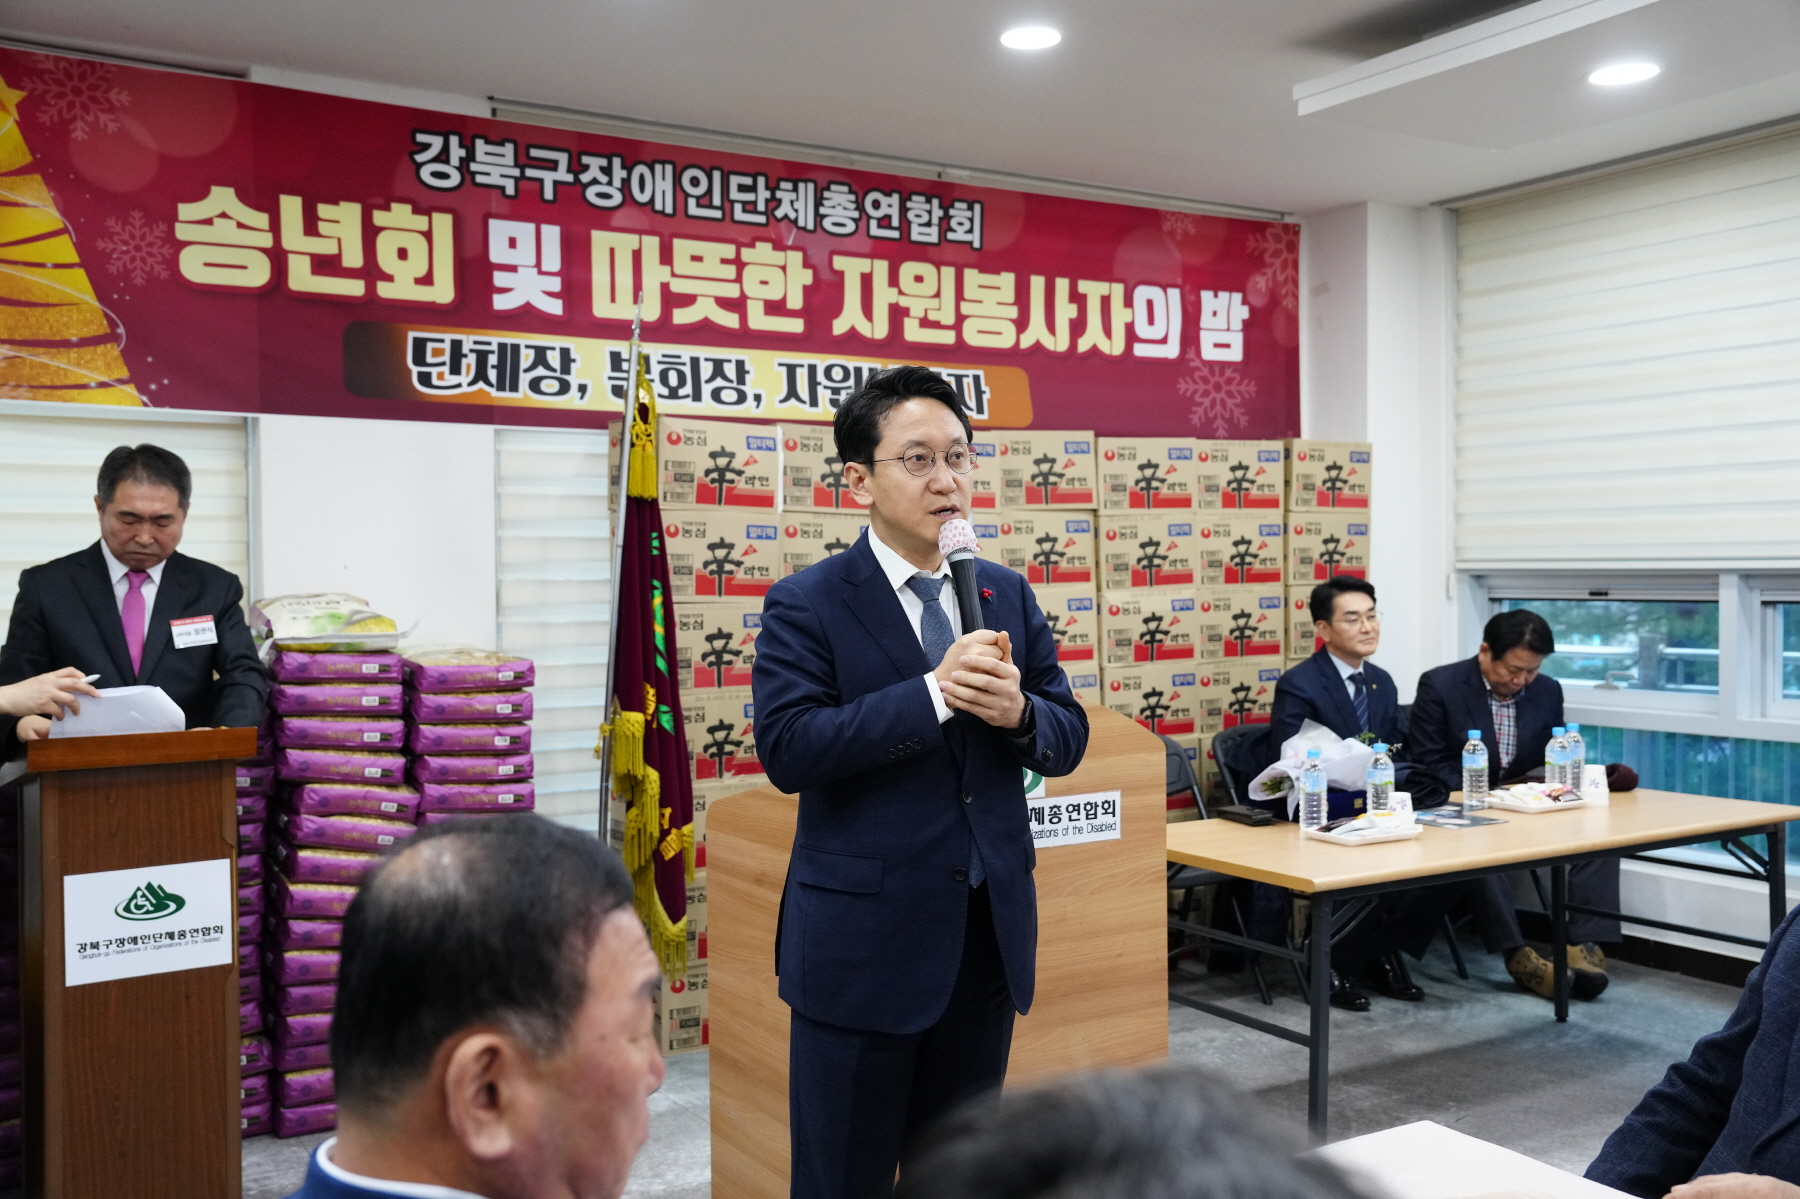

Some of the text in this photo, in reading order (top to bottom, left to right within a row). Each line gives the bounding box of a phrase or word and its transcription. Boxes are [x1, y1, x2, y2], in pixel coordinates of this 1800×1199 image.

[412, 130, 983, 248] 강북구장애인단체총연합회
[175, 185, 1250, 362] 송년회 및 따뜻한 자원봉사자의 밤
[408, 331, 588, 400] 단체장,
[778, 362, 988, 416] 자원자
[683, 434, 707, 446] 농심
[800, 441, 823, 452] 농심
[704, 445, 745, 505] 辛
[744, 475, 770, 488] 라면
[1031, 453, 1065, 505] 辛
[1134, 459, 1167, 509] 辛
[1226, 460, 1256, 509] 辛
[1322, 460, 1349, 508] 辛
[682, 527, 706, 538] 농심
[800, 528, 823, 539] 농심
[1319, 533, 1347, 578] 辛
[703, 536, 744, 597] 辛
[743, 565, 770, 578] 라면
[1033, 532, 1066, 584] 辛
[1136, 536, 1168, 587] 辛
[1230, 535, 1259, 584] 辛
[679, 619, 704, 631] 농심
[744, 615, 761, 627] 멀티
[1139, 611, 1171, 662] 辛
[1229, 608, 1259, 657] 辛
[701, 627, 743, 688] 辛
[1140, 686, 1171, 733] 辛
[1228, 682, 1258, 725] 辛
[703, 719, 743, 778] 辛
[1029, 799, 1116, 826] 체총연합회
[1062, 825, 1069, 836] of
[1072, 824, 1084, 835] the
[1086, 820, 1117, 834] Disabled
[76, 925, 224, 954] 강북구장애인단체총연합회
